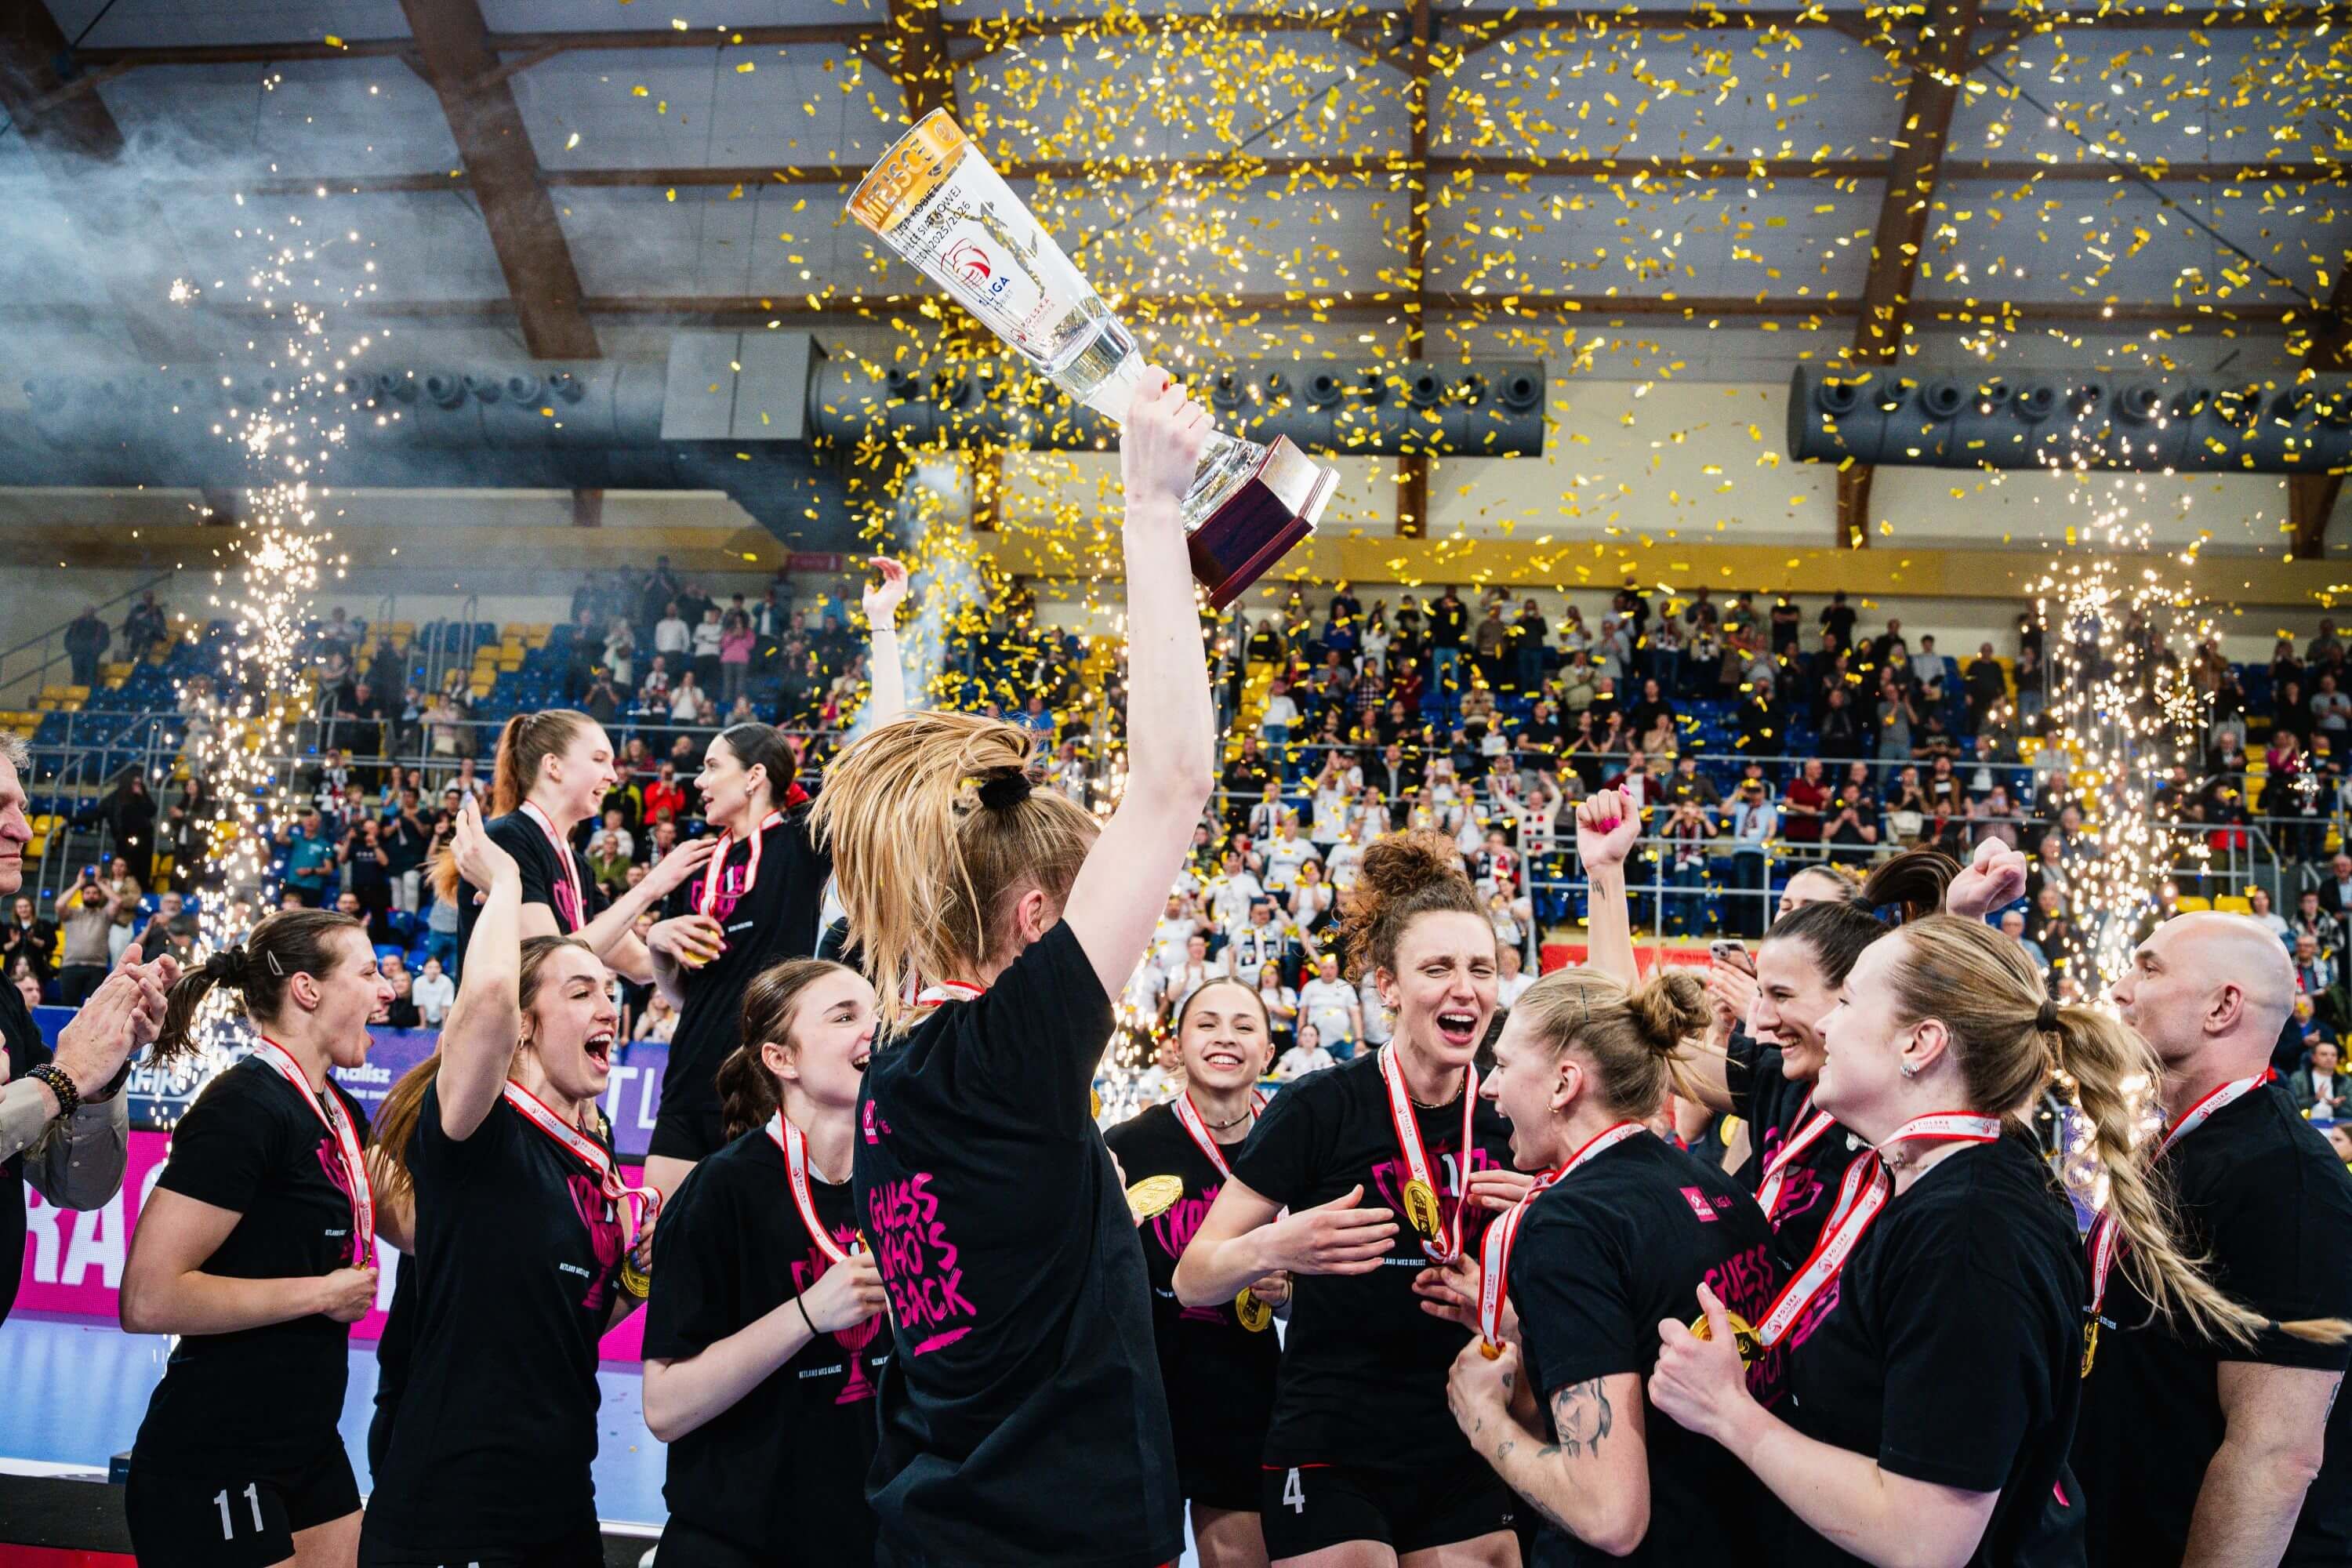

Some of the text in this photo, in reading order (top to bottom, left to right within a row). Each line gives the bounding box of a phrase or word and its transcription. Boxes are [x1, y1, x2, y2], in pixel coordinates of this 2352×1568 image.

[910, 184, 940, 217] KOBIET
[917, 185, 962, 236] SIATKOWEJ
[927, 200, 971, 249] 2025/2026
[336, 1062, 391, 1083] Kalisz
[869, 1173, 938, 1236] GUESS
[877, 1221, 958, 1281] WHO'S
[1409, 1258, 1426, 1266] KALISZ
[1704, 1242, 1774, 1308] GUESS
[890, 1268, 977, 1329] BACK
[1777, 1294, 1797, 1318] POLSKA
[818, 1367, 828, 1376] MKS
[214, 1483, 263, 1540] 11
[1283, 1467, 1305, 1514] 4
